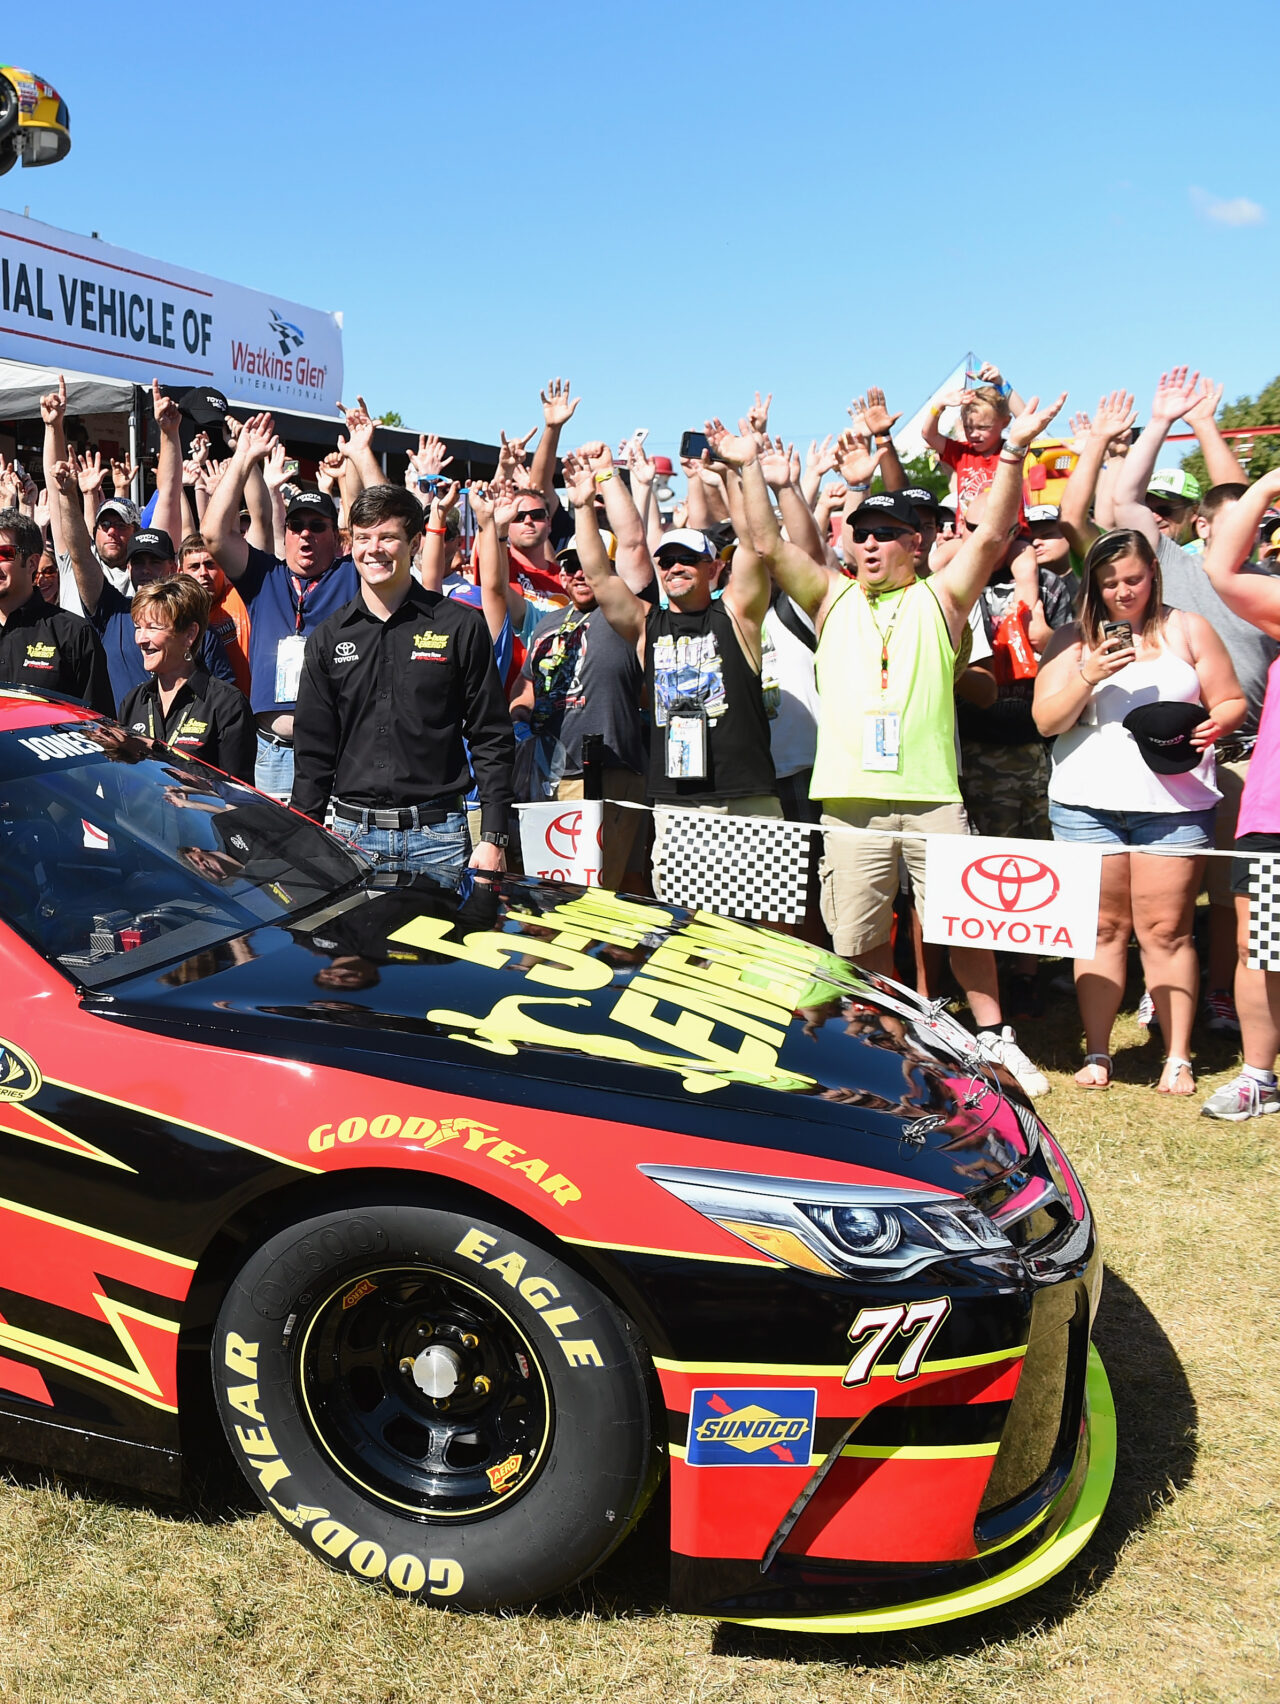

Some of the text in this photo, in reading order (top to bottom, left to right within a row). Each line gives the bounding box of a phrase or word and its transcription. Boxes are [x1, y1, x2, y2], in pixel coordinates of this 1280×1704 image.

[58, 273, 175, 349] VEHICLE
[182, 308, 213, 356] OF
[232, 340, 293, 382] Watkins
[234, 376, 323, 401] INTERNATIONAL
[334, 655, 359, 664] TOYOTA
[18, 731, 105, 761] JONES
[942, 915, 1073, 949] TOYOTA
[347, 1284, 369, 1304] AERO
[454, 1227, 605, 1368] EAGLE
[841, 1295, 951, 1389] 77
[699, 1417, 808, 1442] SUNOCO
[492, 1459, 517, 1482] AERO
